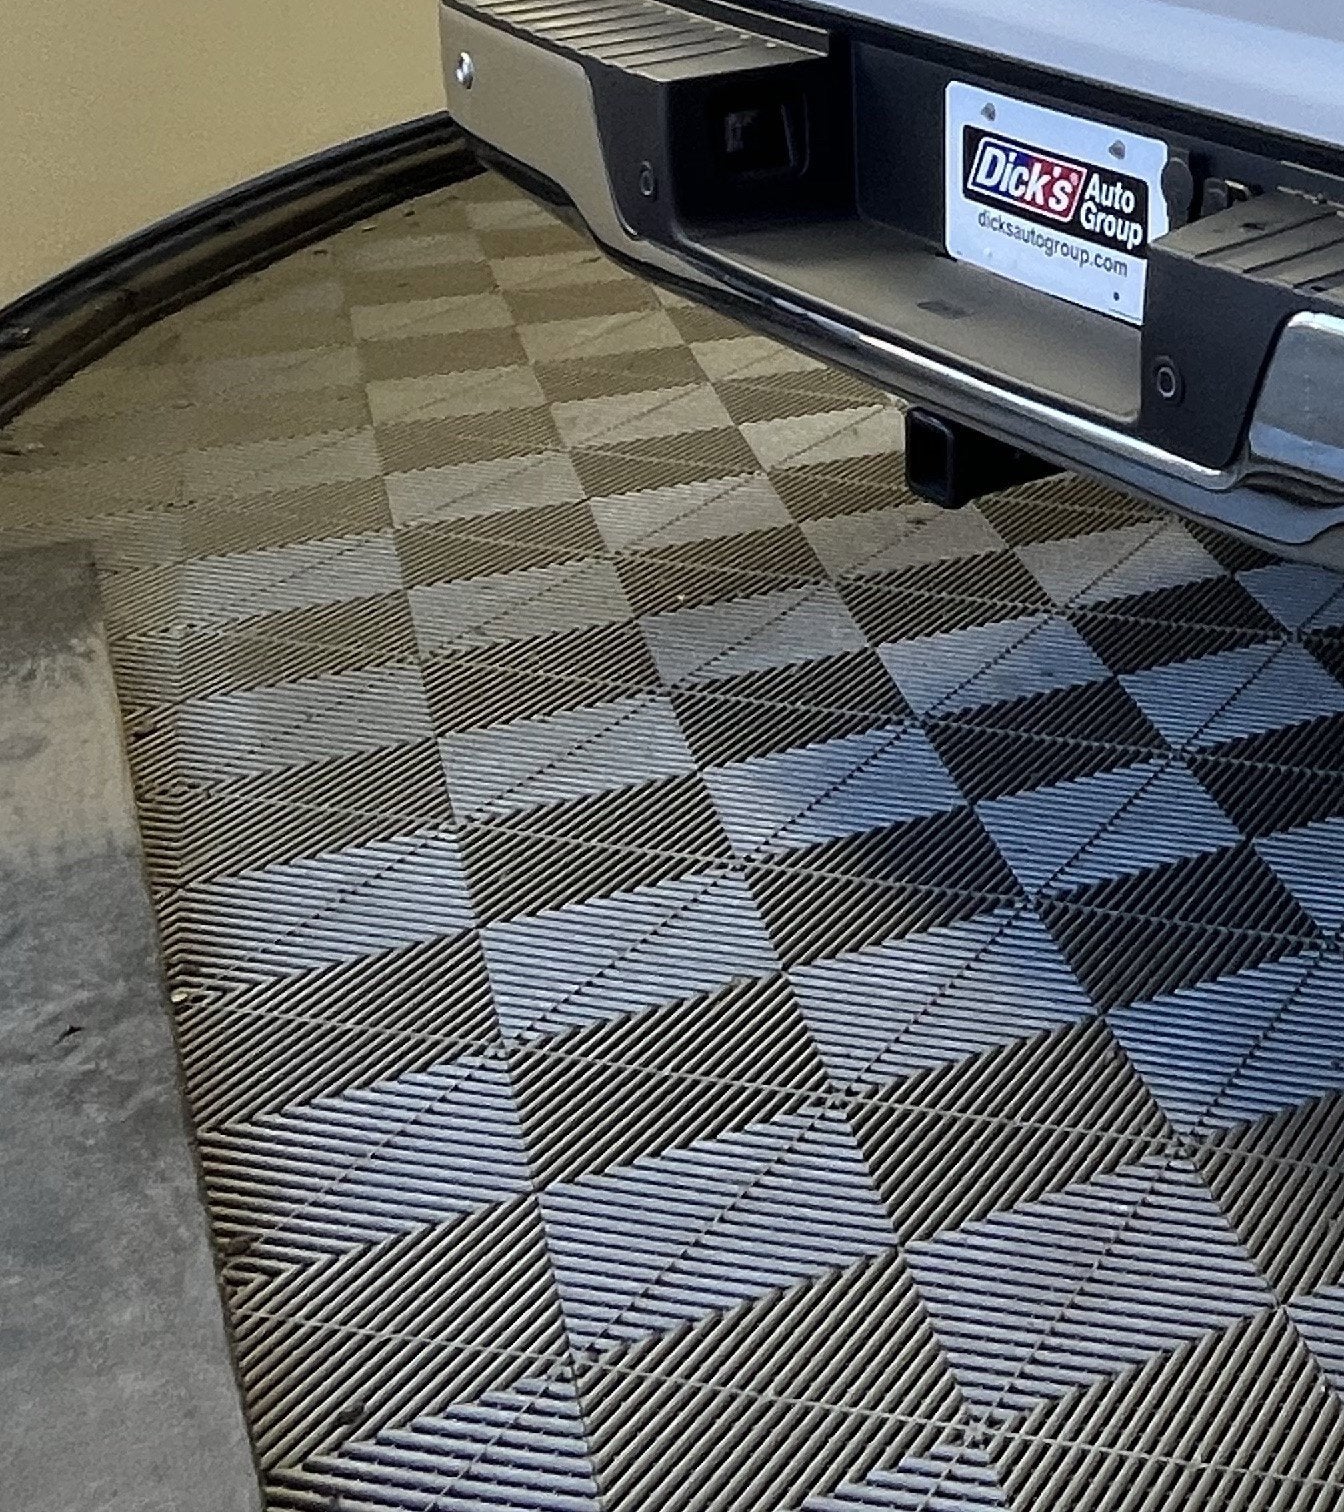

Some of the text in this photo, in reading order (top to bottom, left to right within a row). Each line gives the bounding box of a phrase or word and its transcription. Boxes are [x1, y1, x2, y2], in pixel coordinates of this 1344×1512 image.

[974, 145, 1075, 213] Dick's
[1084, 173, 1136, 215] Auto
[977, 209, 1128, 277] dicksautogroup.com
[1080, 199, 1144, 250] Group
